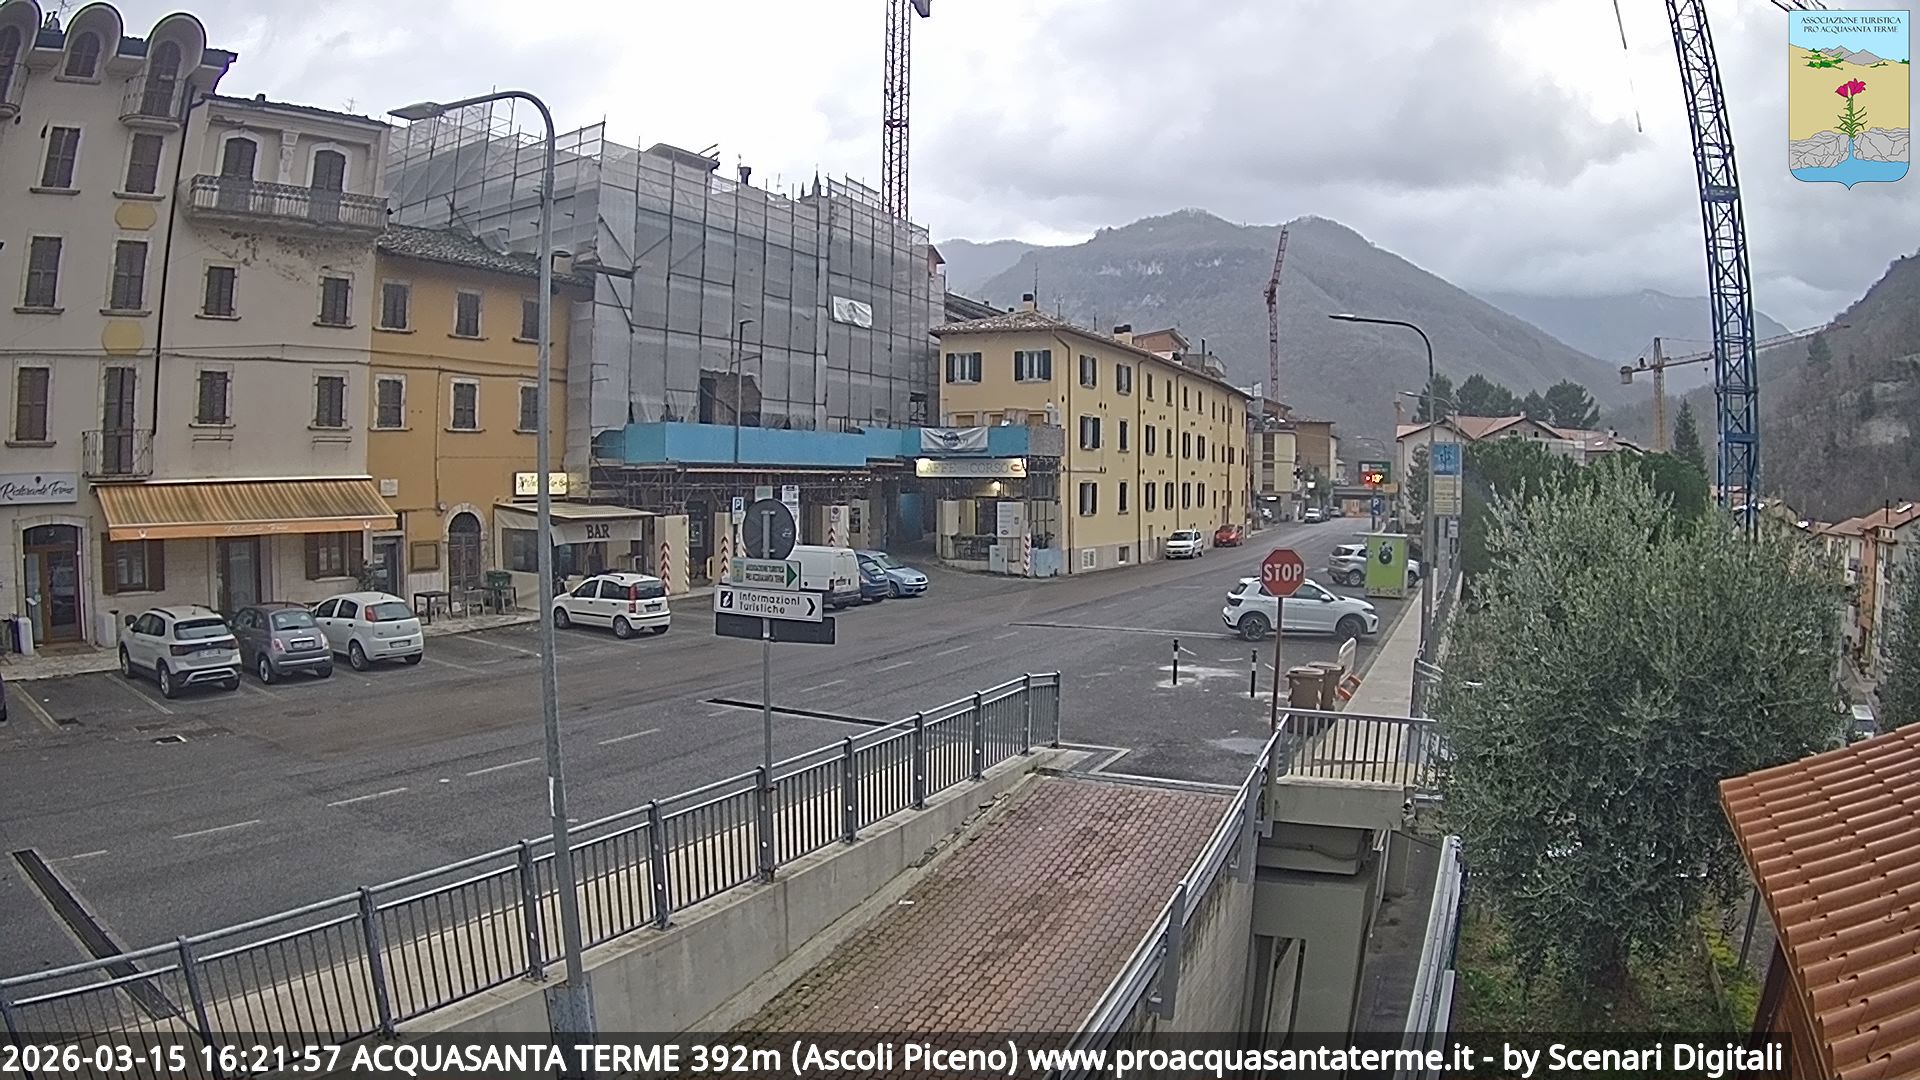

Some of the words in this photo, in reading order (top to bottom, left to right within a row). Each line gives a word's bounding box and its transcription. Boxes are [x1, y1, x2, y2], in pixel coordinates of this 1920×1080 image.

[969, 462, 1009, 474] CORSO
[585, 523, 611, 540] BAR
[1263, 563, 1303, 582] STOP
[739, 591, 800, 606] Informazioni
[739, 601, 785, 615] Turistiche
